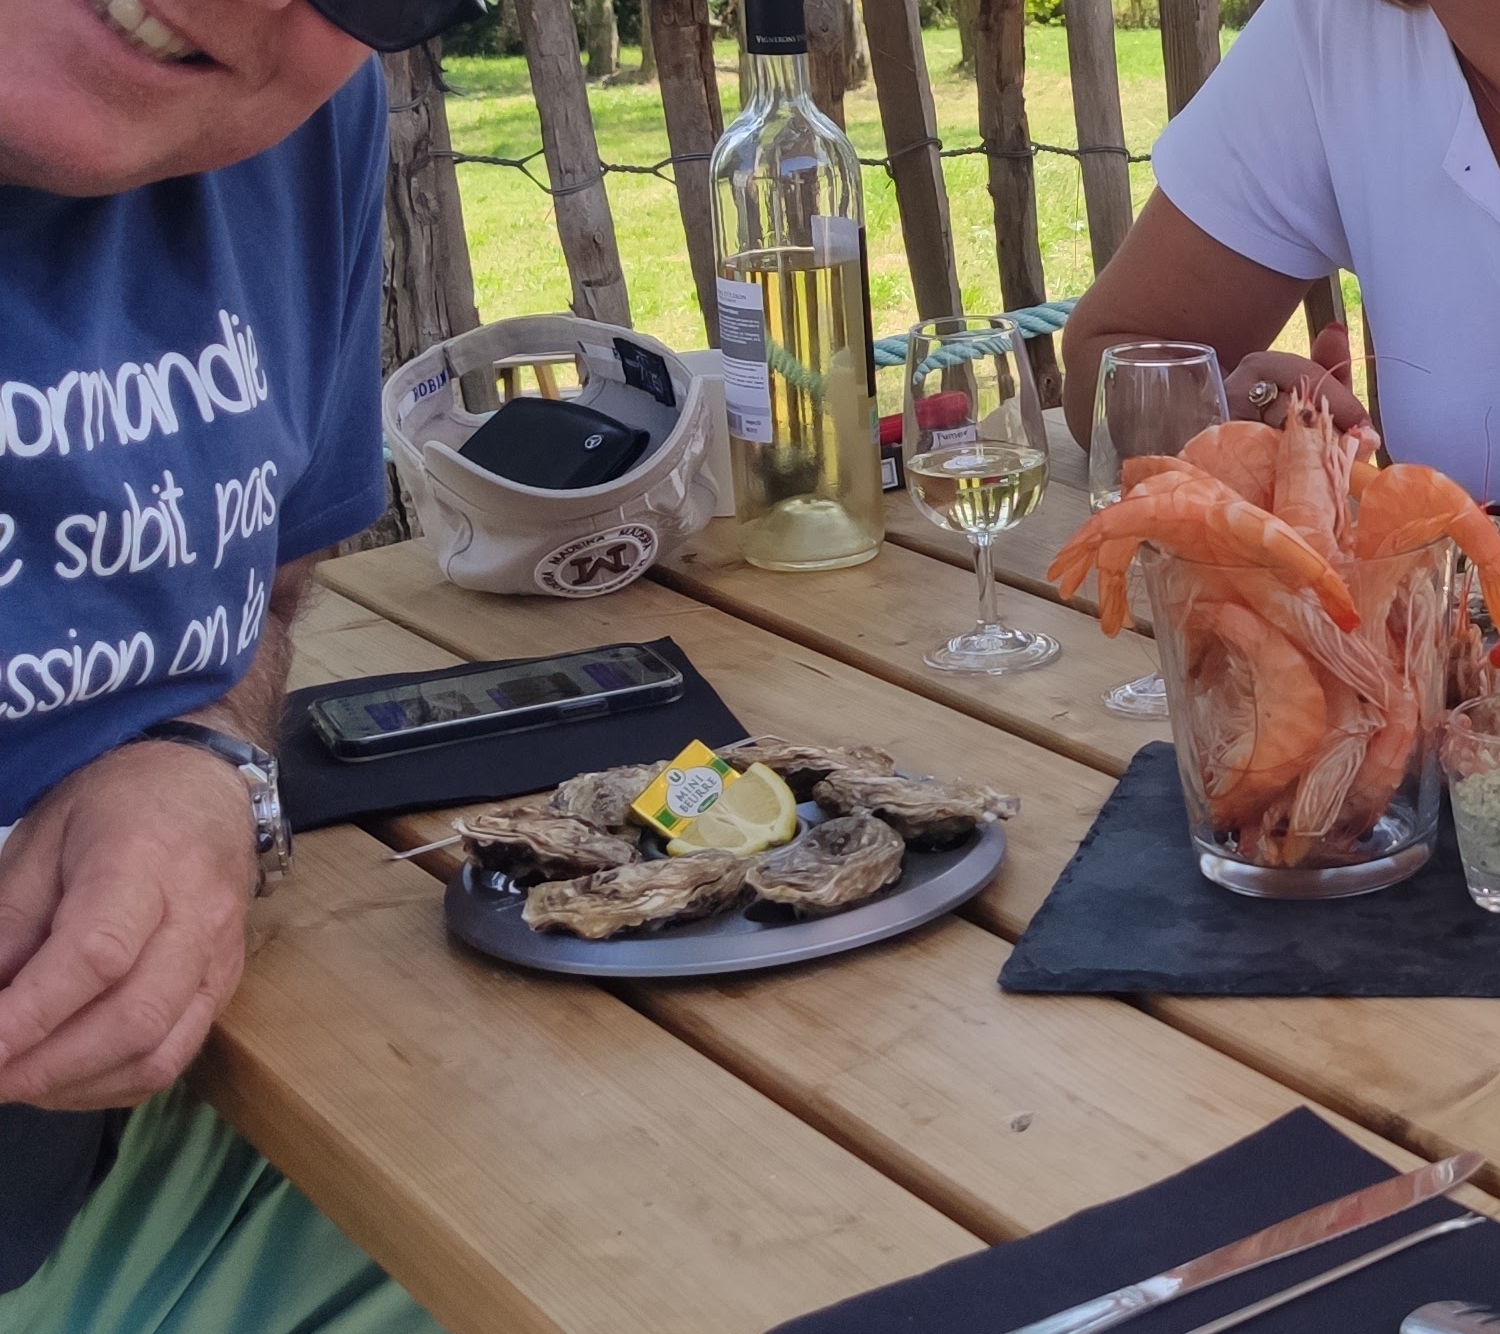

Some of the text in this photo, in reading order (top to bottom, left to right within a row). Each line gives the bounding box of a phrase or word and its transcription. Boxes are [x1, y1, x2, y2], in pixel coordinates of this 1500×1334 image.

[0, 309, 268, 457] ormandie
[54, 469, 197, 579] subit
[213, 460, 278, 569] pas
[0, 567, 265, 720] ssion on la
[668, 771, 682, 783] U
[675, 774, 704, 802] MINI
[679, 776, 718, 813] BEURRE
